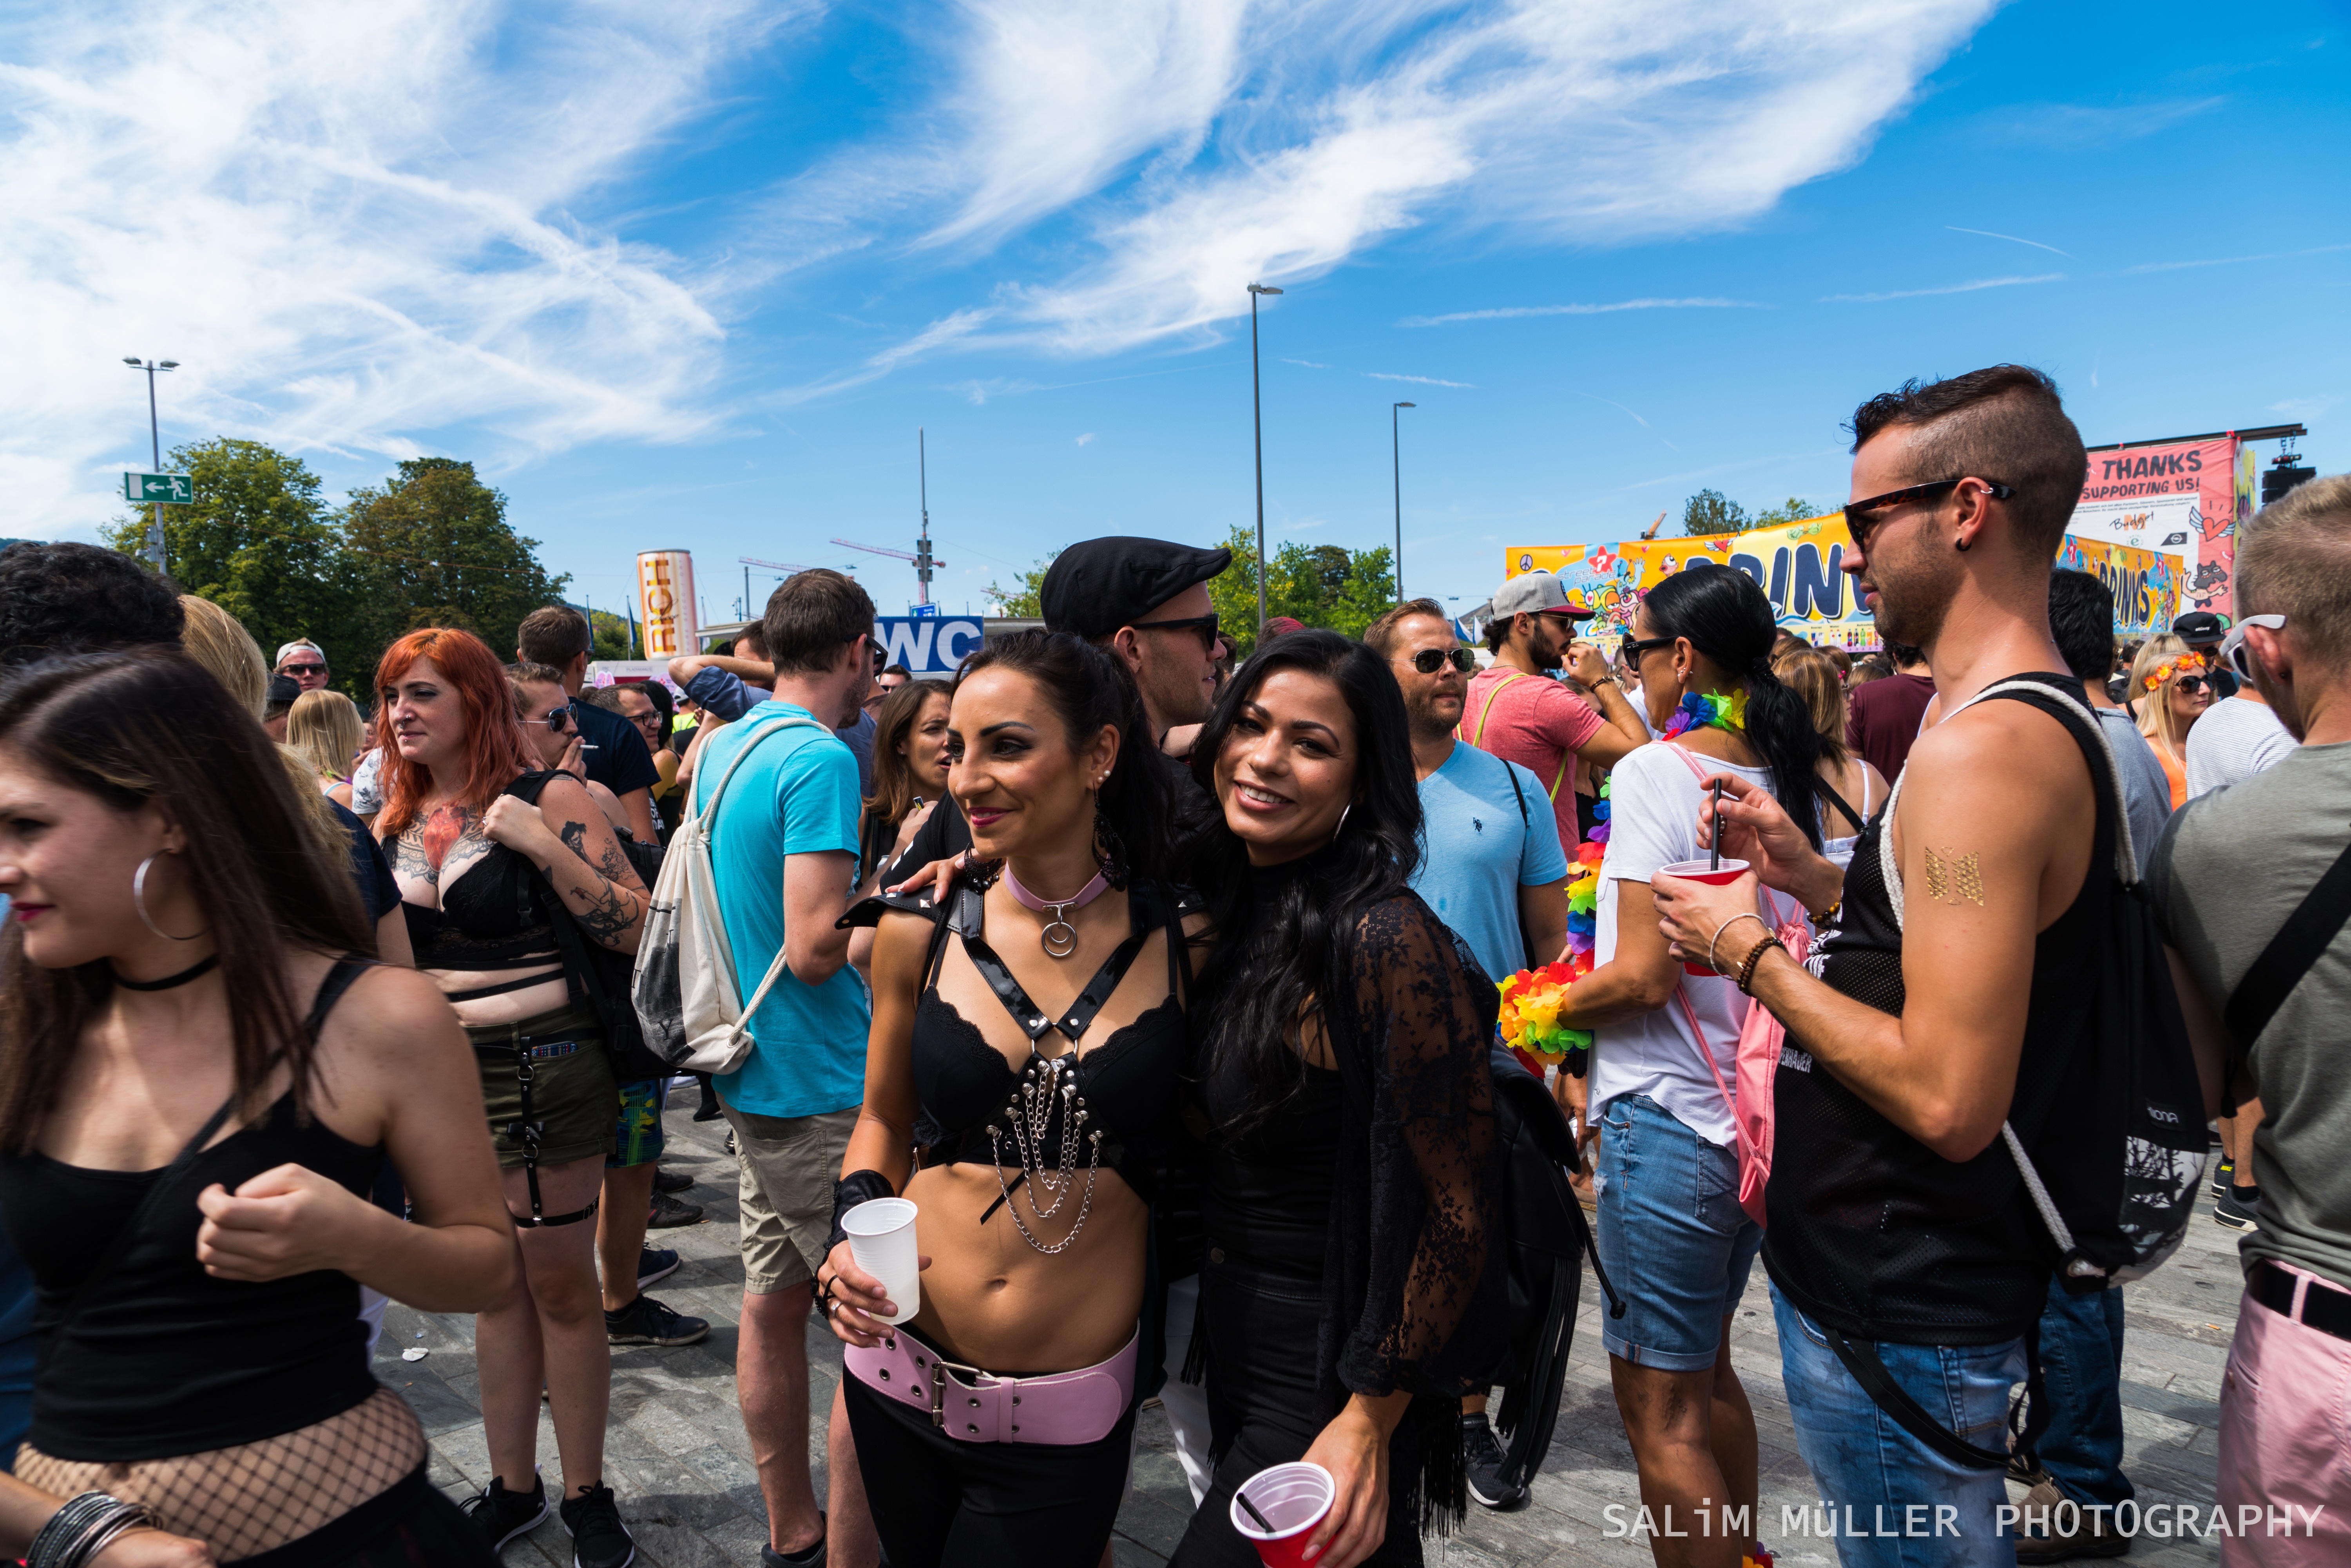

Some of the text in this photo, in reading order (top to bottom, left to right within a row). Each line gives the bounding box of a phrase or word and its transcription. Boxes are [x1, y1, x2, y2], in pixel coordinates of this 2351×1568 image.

[2102, 450, 2202, 480] THANKS
[2083, 477, 2200, 499] SUPPORTING US!
[2109, 511, 2154, 531] Budget
[1558, 566, 1596, 580] street
[1574, 569, 1616, 587] parade
[645, 559, 676, 652] RICH
[874, 621, 982, 671] WC
